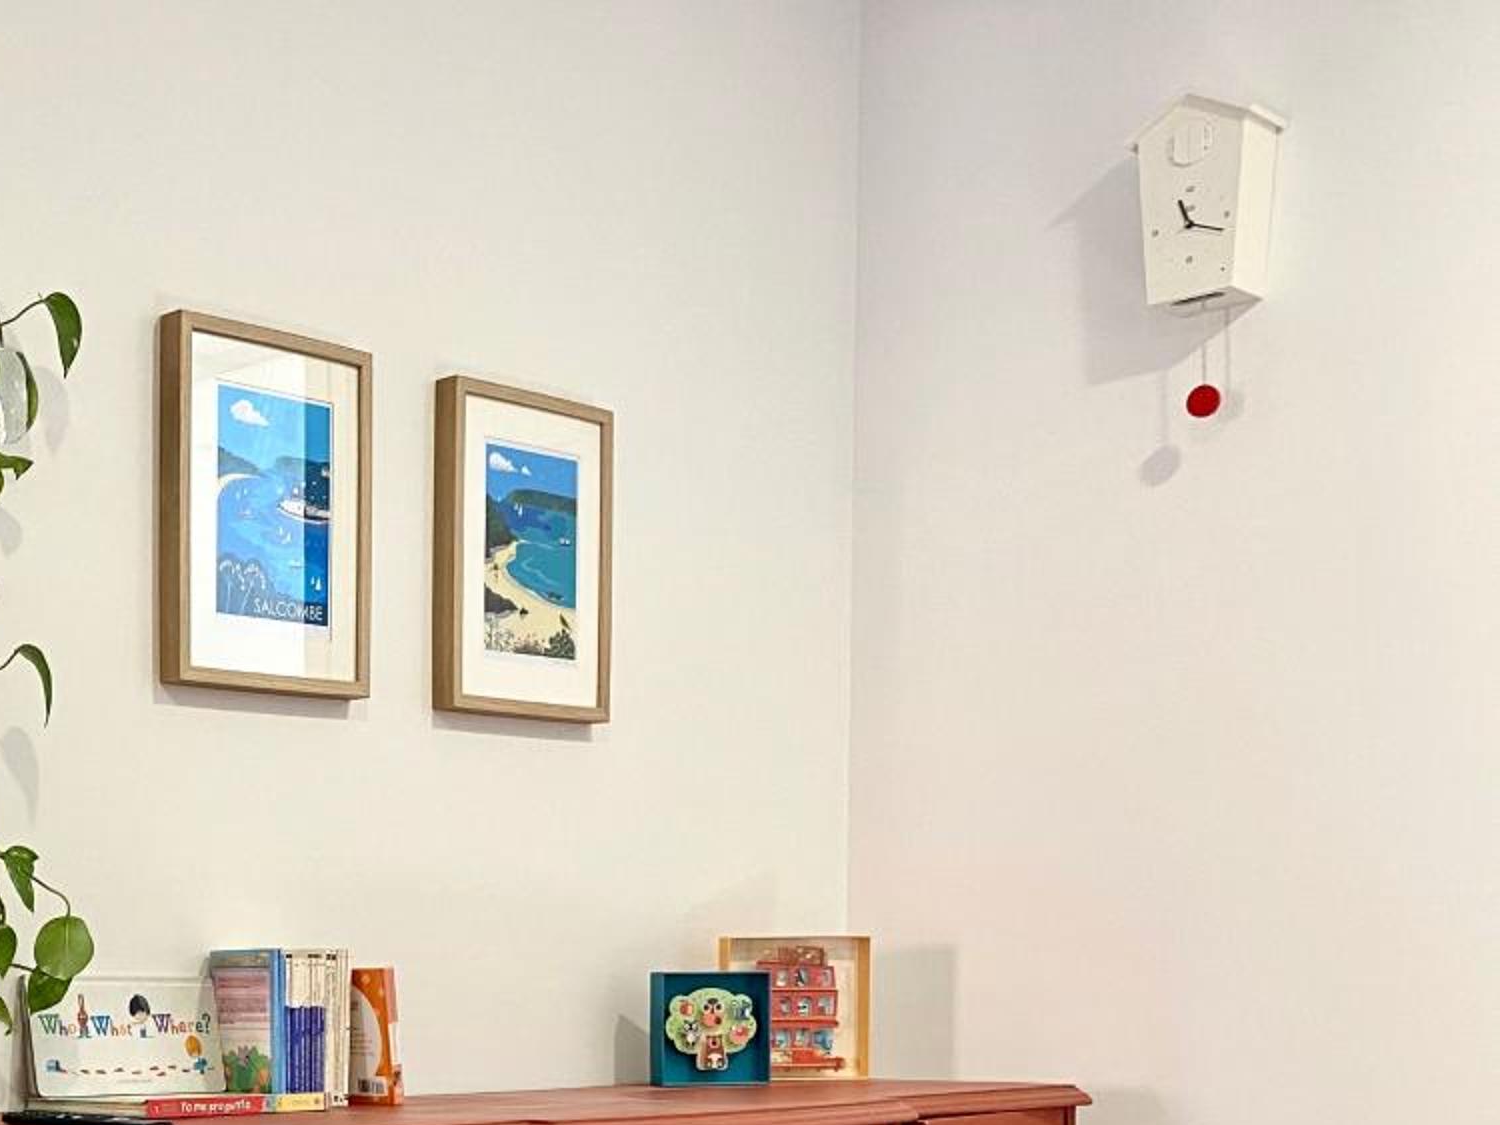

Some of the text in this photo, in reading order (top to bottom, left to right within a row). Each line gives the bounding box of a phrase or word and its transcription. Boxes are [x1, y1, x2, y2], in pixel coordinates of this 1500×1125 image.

[254, 598, 323, 621] SALCOMBE
[38, 1013, 211, 1037] Who What Where?
